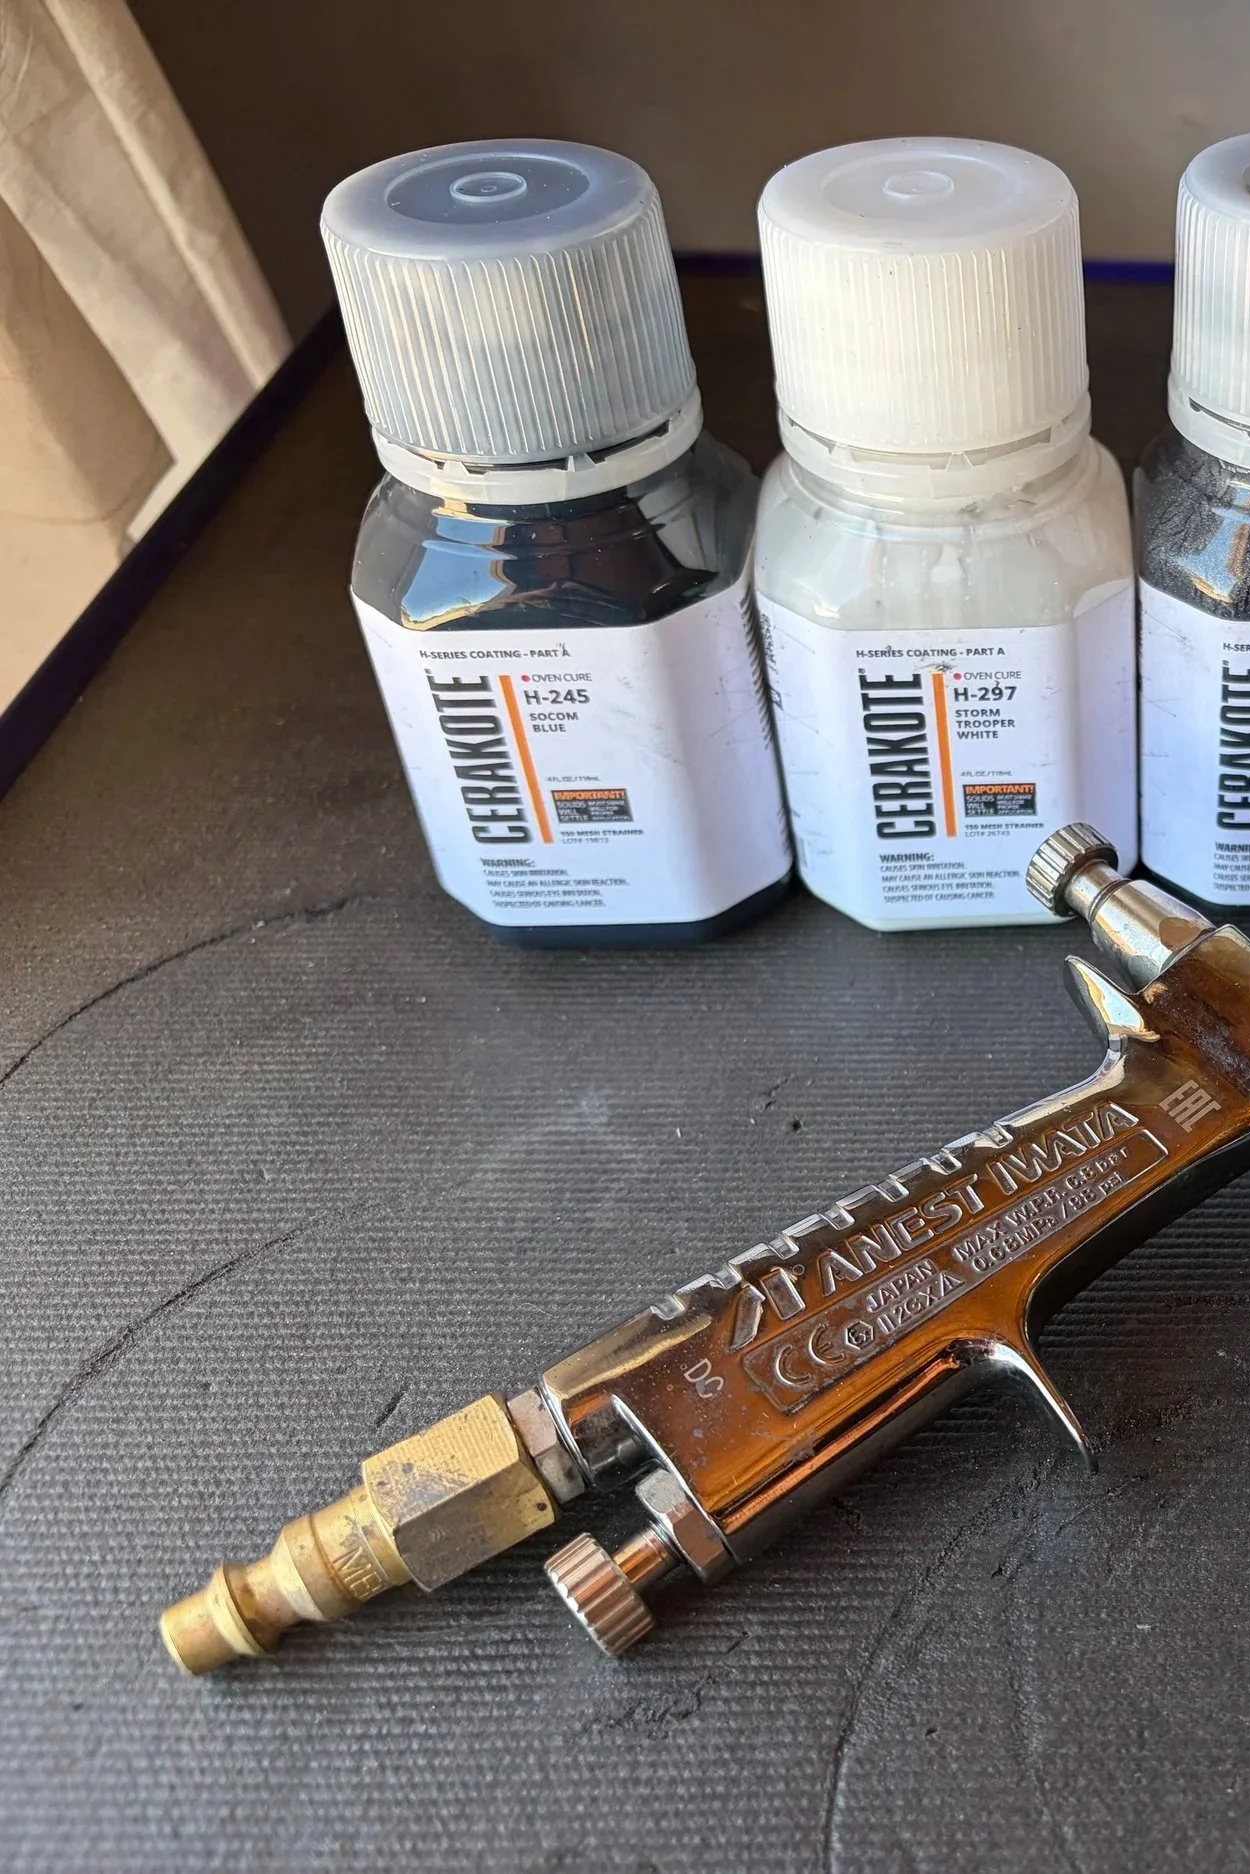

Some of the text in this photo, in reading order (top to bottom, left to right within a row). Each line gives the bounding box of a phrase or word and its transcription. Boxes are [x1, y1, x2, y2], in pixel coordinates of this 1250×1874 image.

[419, 650, 467, 660] H-SERIES
[470, 650, 521, 659] COATING
[530, 649, 558, 658] PART
[562, 648, 571, 658] A
[856, 649, 904, 658] H-SERIES
[907, 649, 957, 658] COATING
[966, 648, 994, 656] PART
[996, 648, 1006, 656] A
[532, 673, 592, 683] OVEN CURE
[964, 670, 1022, 680] OVEN CURE
[523, 689, 591, 706] H-245
[953, 686, 1018, 702] H-297
[529, 712, 579, 722] SOCOM
[955, 708, 1001, 718] STORM
[533, 724, 566, 733] BLUE
[956, 719, 1016, 729] TROOPER
[957, 730, 999, 740] WHITE
[426, 674, 533, 844] CERAKOTE
[859, 672, 937, 840] CERAKOTE
[965, 785, 1034, 794] IMPORTANT!
[553, 791, 625, 800] IMPORTANT!
[480, 858, 535, 867] WARNING:
[880, 853, 934, 863] WARNING:
[817, 1100, 1140, 1297] ANEST IWATA
[952, 1220, 1005, 1263] MAX
[1099, 1146, 1129, 1174] bar
[866, 1258, 938, 1313] JAPAN
